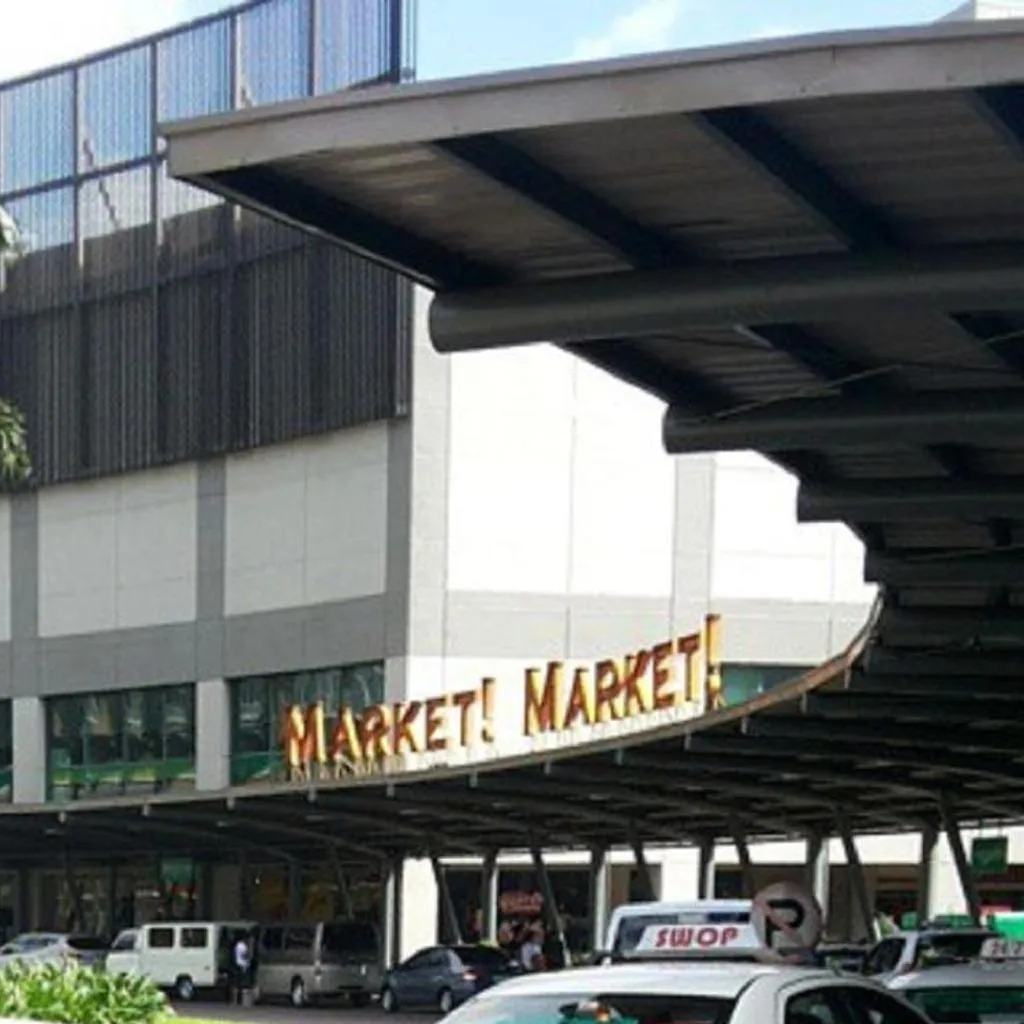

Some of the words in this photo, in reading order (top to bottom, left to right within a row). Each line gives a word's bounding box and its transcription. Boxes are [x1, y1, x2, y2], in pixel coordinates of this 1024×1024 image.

[285, 677, 495, 766] MARKET!
[524, 613, 722, 736] MARKET!
[655, 927, 740, 948] SWOP
[764, 899, 805, 948] P
